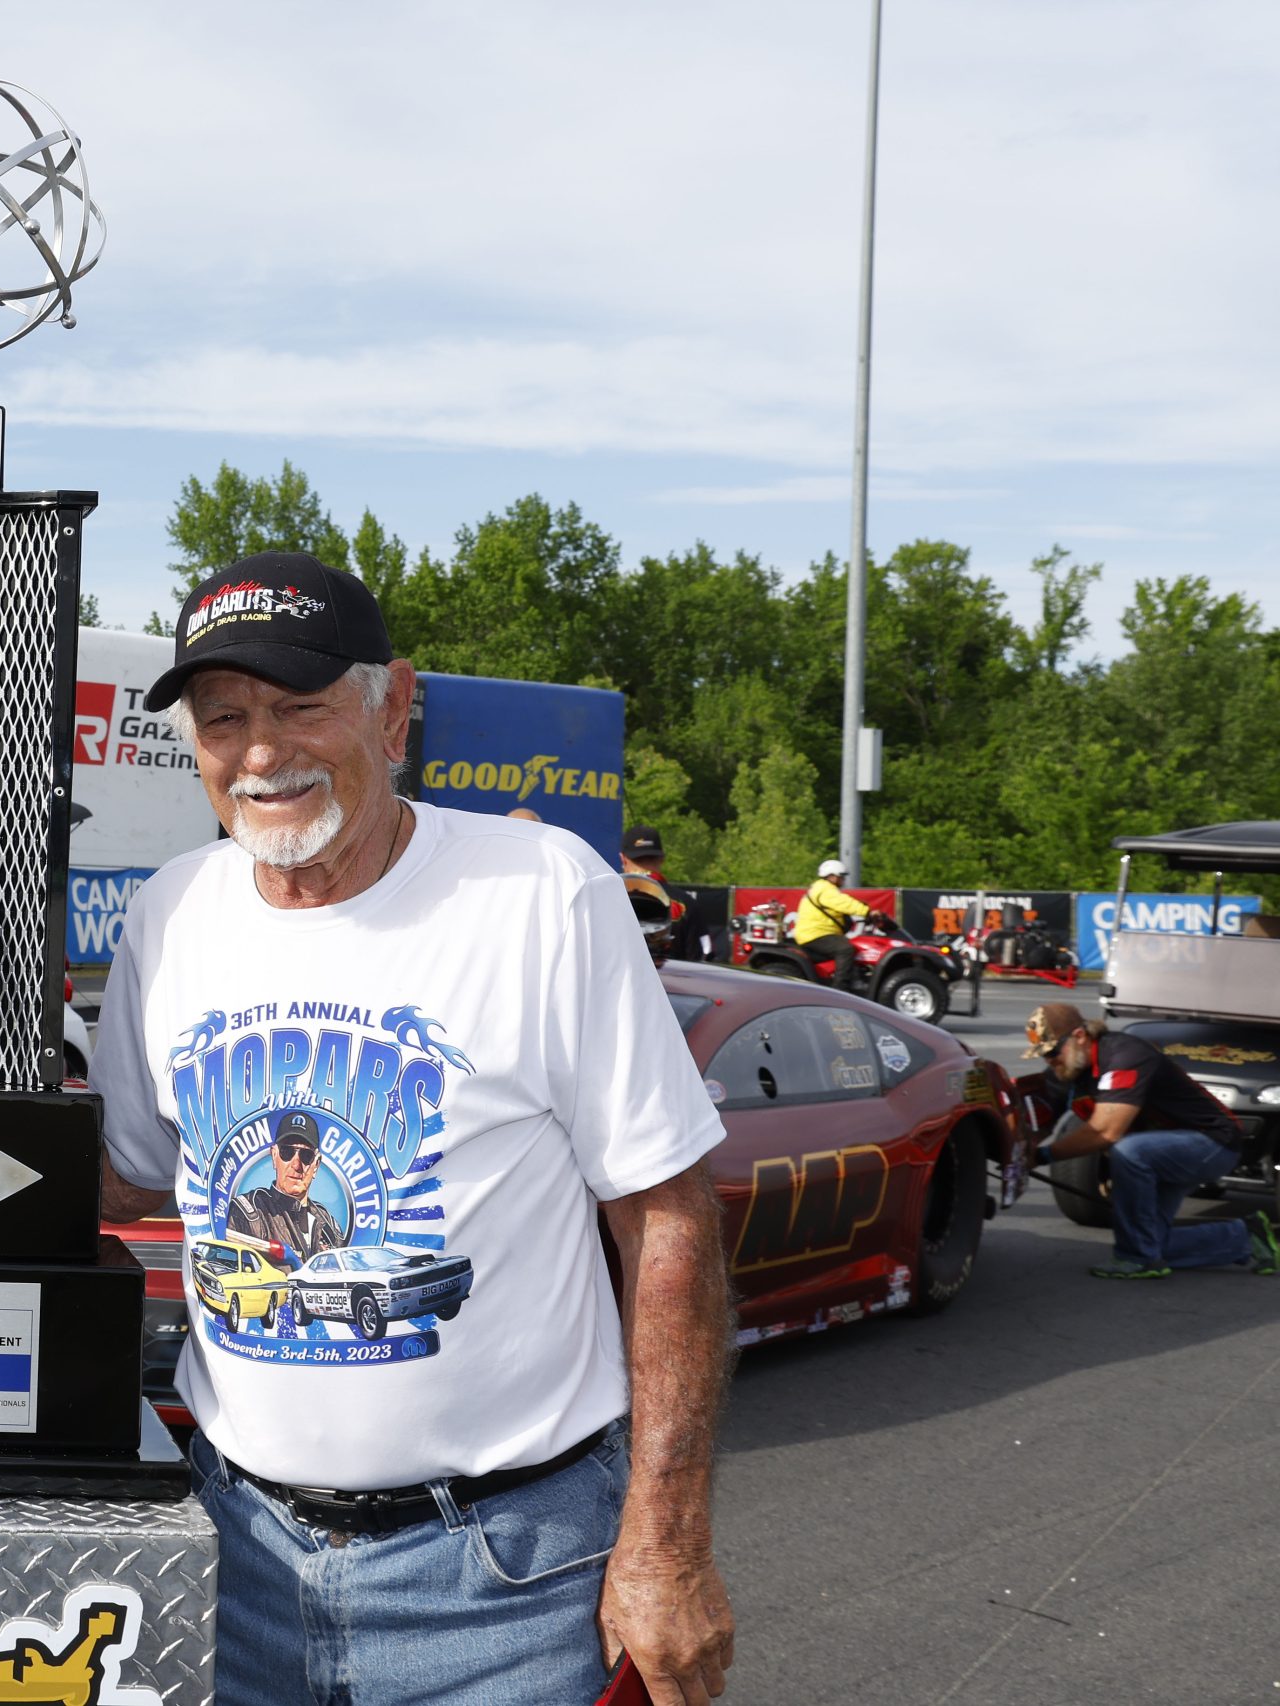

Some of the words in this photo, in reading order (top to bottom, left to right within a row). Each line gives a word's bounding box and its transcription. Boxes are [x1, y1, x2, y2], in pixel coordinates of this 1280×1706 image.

[187, 605, 210, 637] DON
[211, 589, 274, 619] GARLITS
[186, 627, 207, 647] MUSEUM
[207, 623, 215, 633] OF
[217, 614, 237, 627] DRAG
[241, 613, 272, 621] RACING
[120, 716, 176, 742] GAZ
[72, 877, 146, 912] CAMP
[1093, 902, 1242, 932] CAMPING
[230, 1003, 277, 1030] 36TH
[287, 1001, 376, 1028] ANNUAL
[173, 1027, 445, 1186] MOPARS
[263, 1087, 320, 1113] With
[229, 1117, 273, 1163] DON
[320, 1126, 381, 1230] GARLITS
[325, 1292, 348, 1309] Dodge
[421, 1283, 437, 1297] BIG
[219, 1332, 277, 1359] November
[280, 1346, 342, 1362] 3rd-5th,
[346, 1344, 392, 1361] 2023
